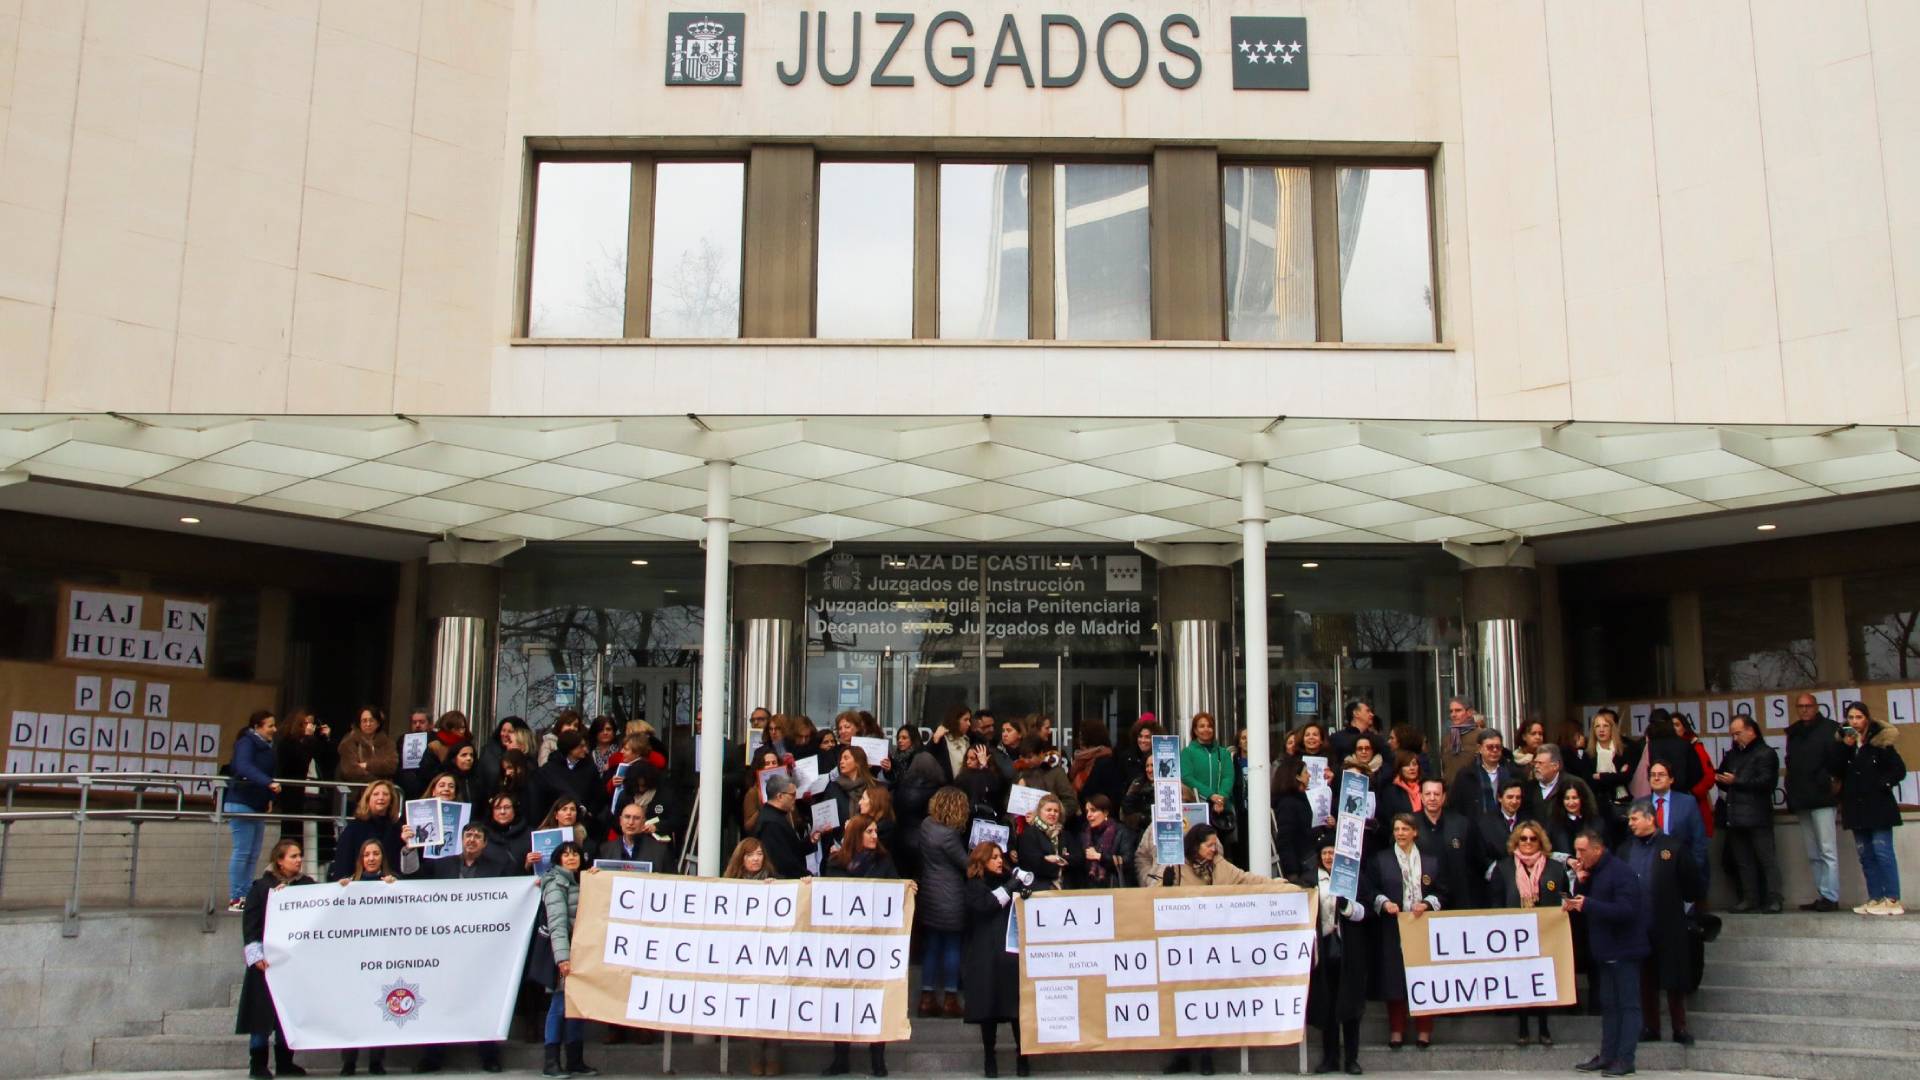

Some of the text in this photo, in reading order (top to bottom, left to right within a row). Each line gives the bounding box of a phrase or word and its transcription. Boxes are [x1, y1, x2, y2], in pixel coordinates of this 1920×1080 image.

[776, 10, 1203, 89] JUZGADOS
[880, 554, 1099, 571] PLAZA DE CASTILLA 1
[867, 576, 1086, 596] Juzgados de Instrucción
[72, 599, 207, 633] LAJ EN
[815, 598, 897, 616] Juzgados
[931, 598, 1022, 617] Vigilancia
[1027, 598, 1141, 614] Penitenciaria
[815, 620, 897, 635] Decanato
[901, 620, 925, 635] de
[959, 620, 1049, 639] Juzgados
[1054, 620, 1076, 635] de
[1081, 620, 1141, 635] Madrid
[71, 632, 205, 665] HUELGA
[79, 686, 163, 714] POR
[15, 722, 216, 754] DIGNIDAD
[279, 891, 509, 912] LETRADOS de la ADMINISTRACIÓN DE JUSTICIA
[618, 888, 893, 919] CUERPO LAJ
[1157, 903, 1192, 912] LETRADOS
[1198, 903, 1207, 911] DE
[1270, 909, 1298, 918] JUSTICIA
[1035, 906, 1102, 929] LAJ
[288, 922, 512, 941] POR EL CUMPLIMIENTO DE LOS ACUERDOS
[1435, 928, 1530, 957] LLOP
[360, 958, 440, 971] POR DIGNIDAD
[613, 935, 902, 971] RECLAMAMOS
[1029, 950, 1078, 960] MINISTRA DE
[1068, 960, 1099, 969] JUSTICIA
[1114, 940, 1311, 972] NO DIALOGA
[1410, 972, 1547, 1006] CUMPLE
[638, 990, 879, 1026] JUSTICIA
[1114, 996, 1303, 1024] NO CUMPLE
